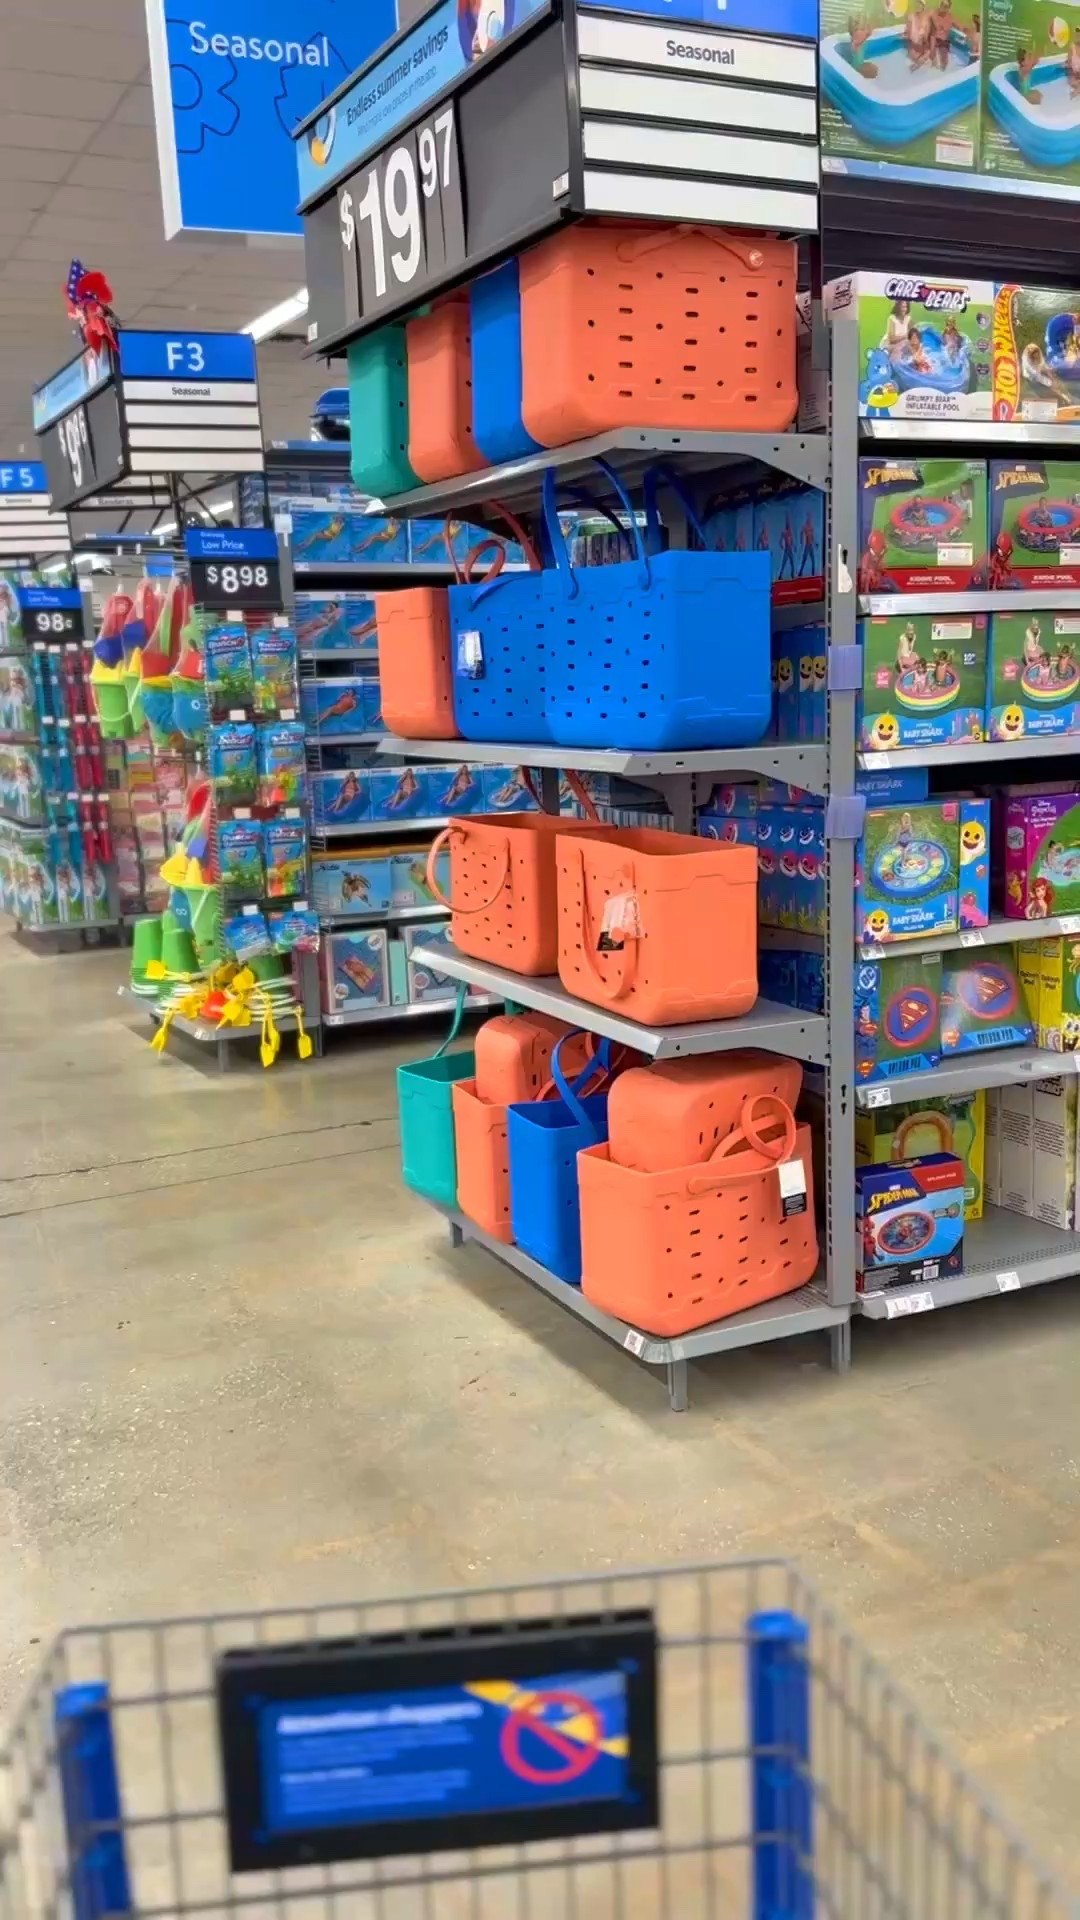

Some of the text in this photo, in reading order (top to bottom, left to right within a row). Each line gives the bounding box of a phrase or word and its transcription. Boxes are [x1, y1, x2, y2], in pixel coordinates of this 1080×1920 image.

[188, 21, 330, 67] Seasonal
[666, 39, 736, 65] Seasonal
[347, 88, 377, 128] Endless
[376, 58, 413, 101] summer
[412, 25, 449, 66] savings
[886, 278, 968, 310] CARE BEARS
[171, 386, 211, 396] Seasonal
[905, 403, 960, 413] INFLATABLE POOL
[860, 968, 877, 988] DC
[866, 1187, 921, 1214] SPIDER-MAN
